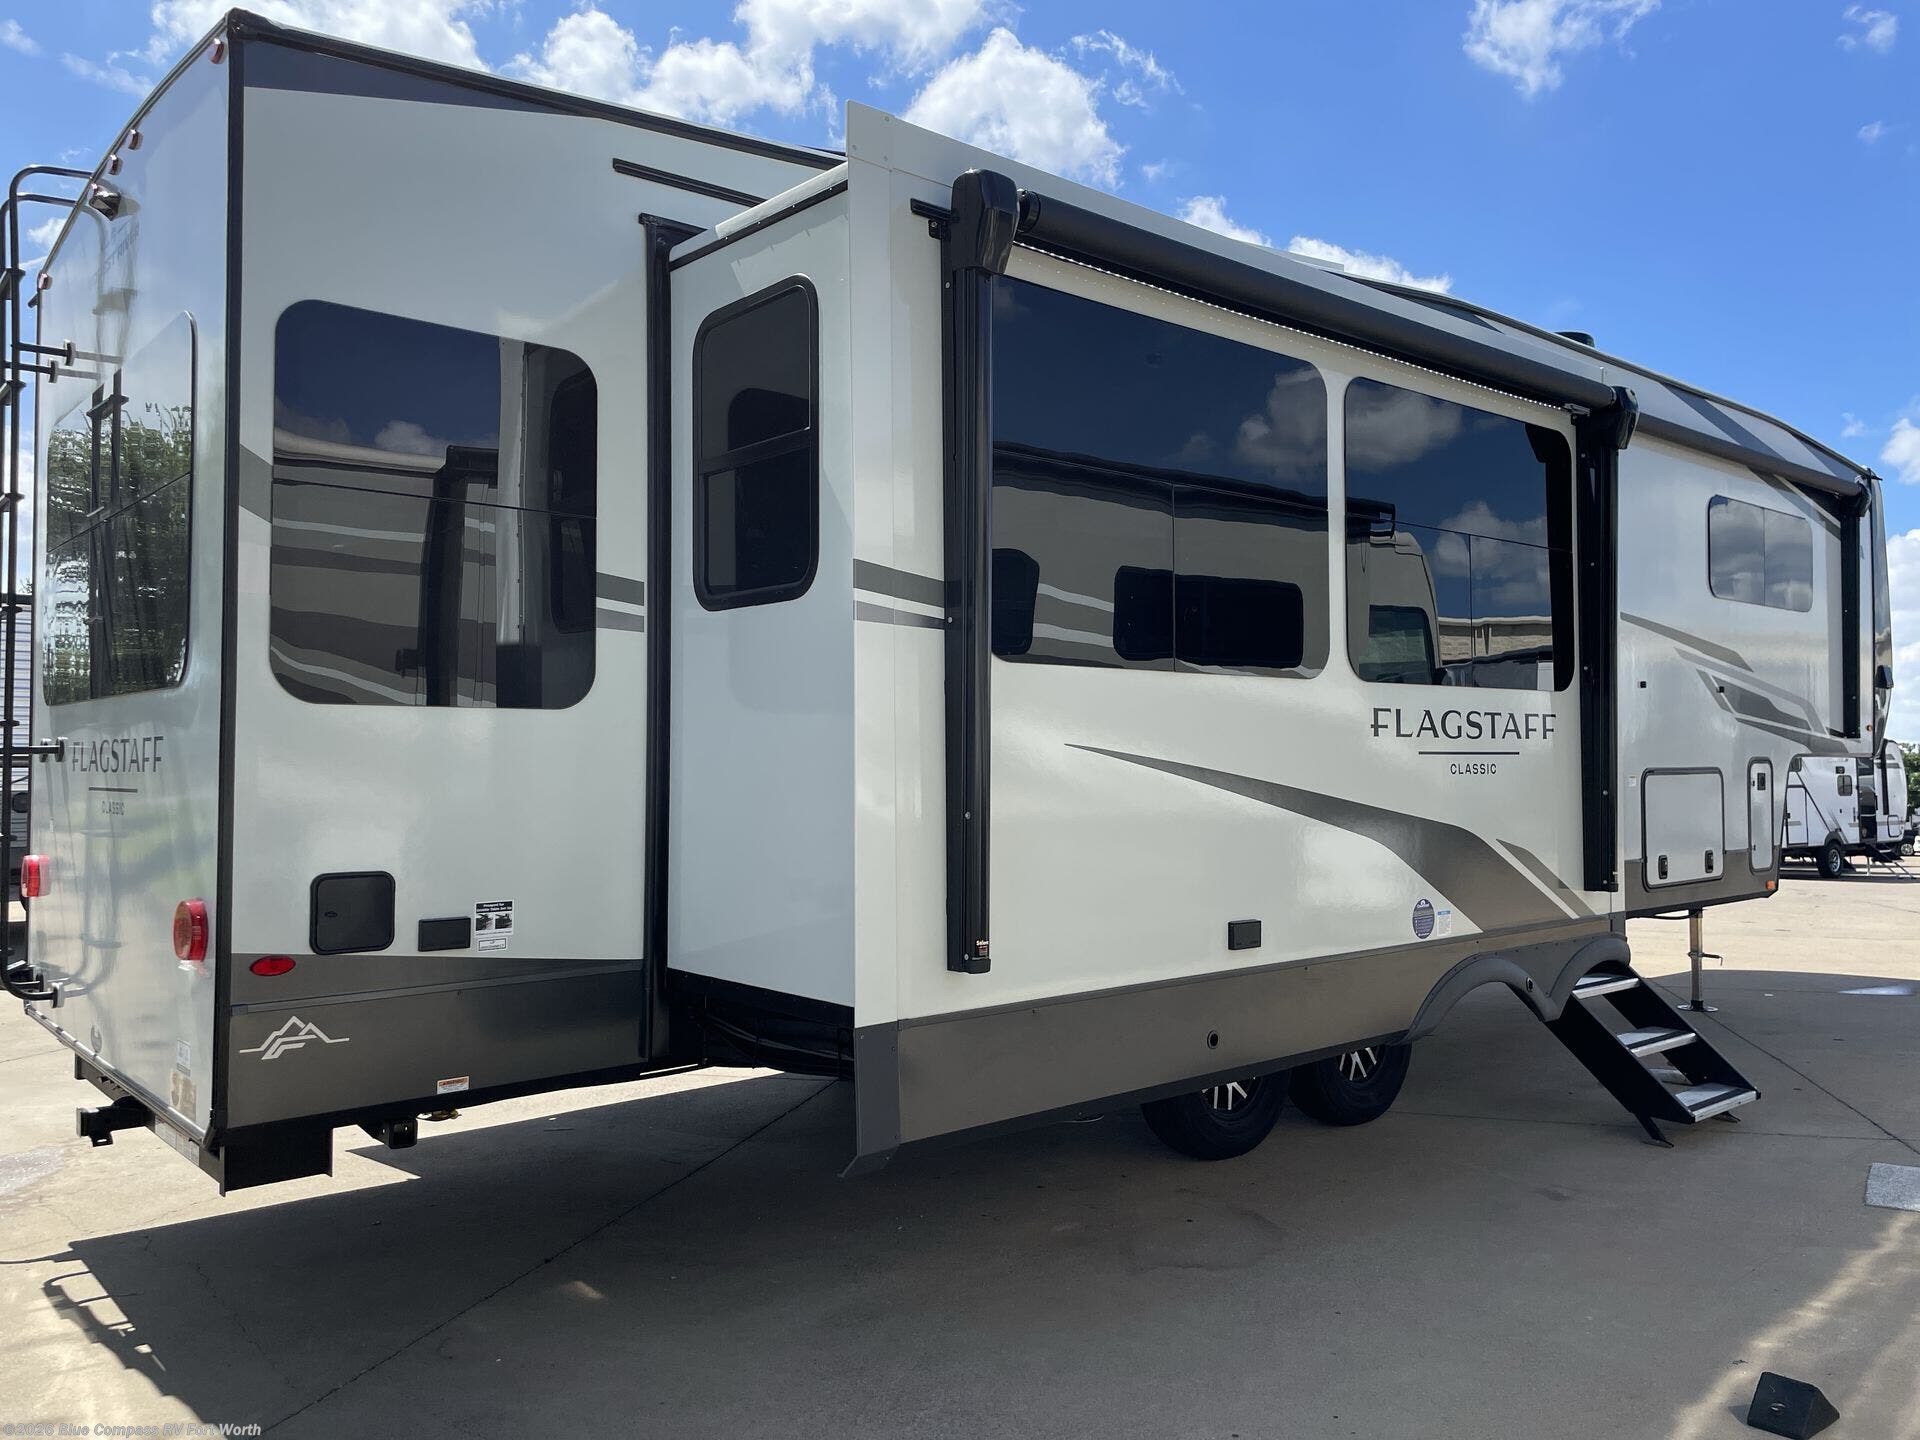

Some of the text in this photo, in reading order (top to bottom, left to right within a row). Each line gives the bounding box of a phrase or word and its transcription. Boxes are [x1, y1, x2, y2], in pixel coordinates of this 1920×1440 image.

[1370, 707, 1556, 740] FLAGSTAFF
[72, 736, 164, 773] FLAGSTAFF
[1450, 763, 1497, 775] CLASSIC
[101, 800, 125, 816] CLASSIC
